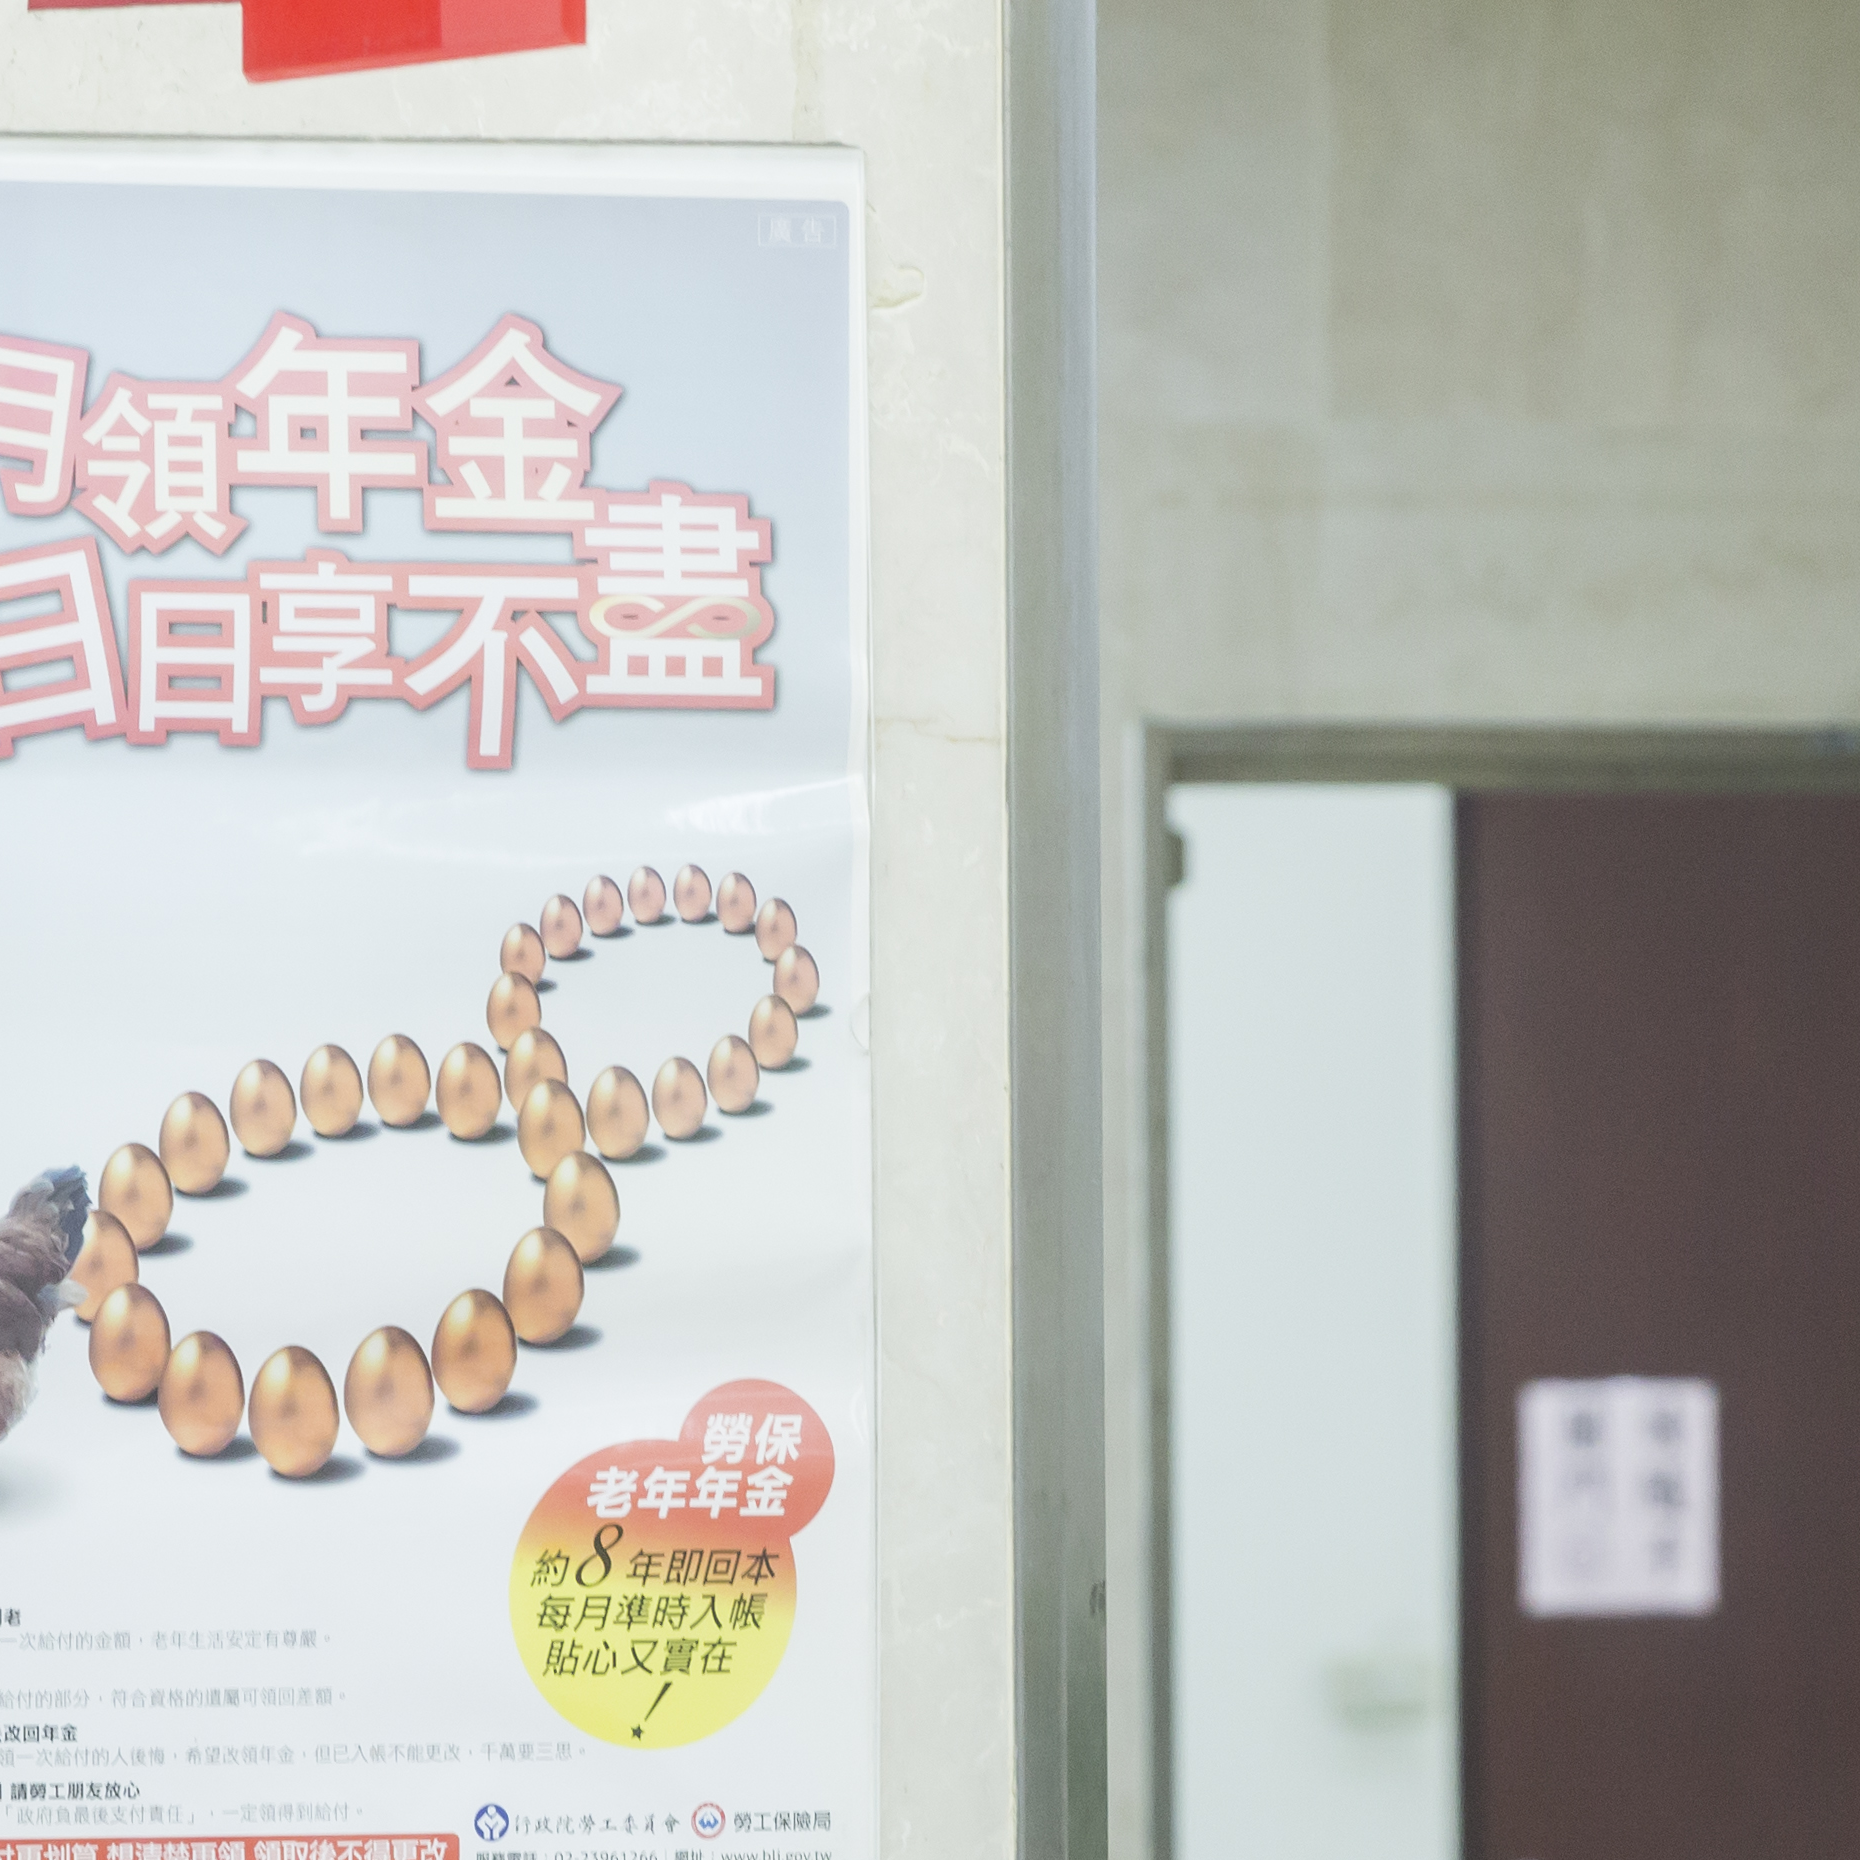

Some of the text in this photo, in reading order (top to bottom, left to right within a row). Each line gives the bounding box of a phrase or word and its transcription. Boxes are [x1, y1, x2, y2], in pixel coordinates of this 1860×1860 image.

[701, 1412, 804, 1466] 勞保
[586, 1465, 795, 1520] 老年年金
[529, 1522, 781, 1588] 約8年即回本
[537, 1592, 769, 1632] 每月準時入帳
[542, 1636, 738, 1677] 貼心又實在
[10, 1780, 141, 1801] 請勞工朋友放心
[733, 1810, 833, 1833] 勞工保險局
